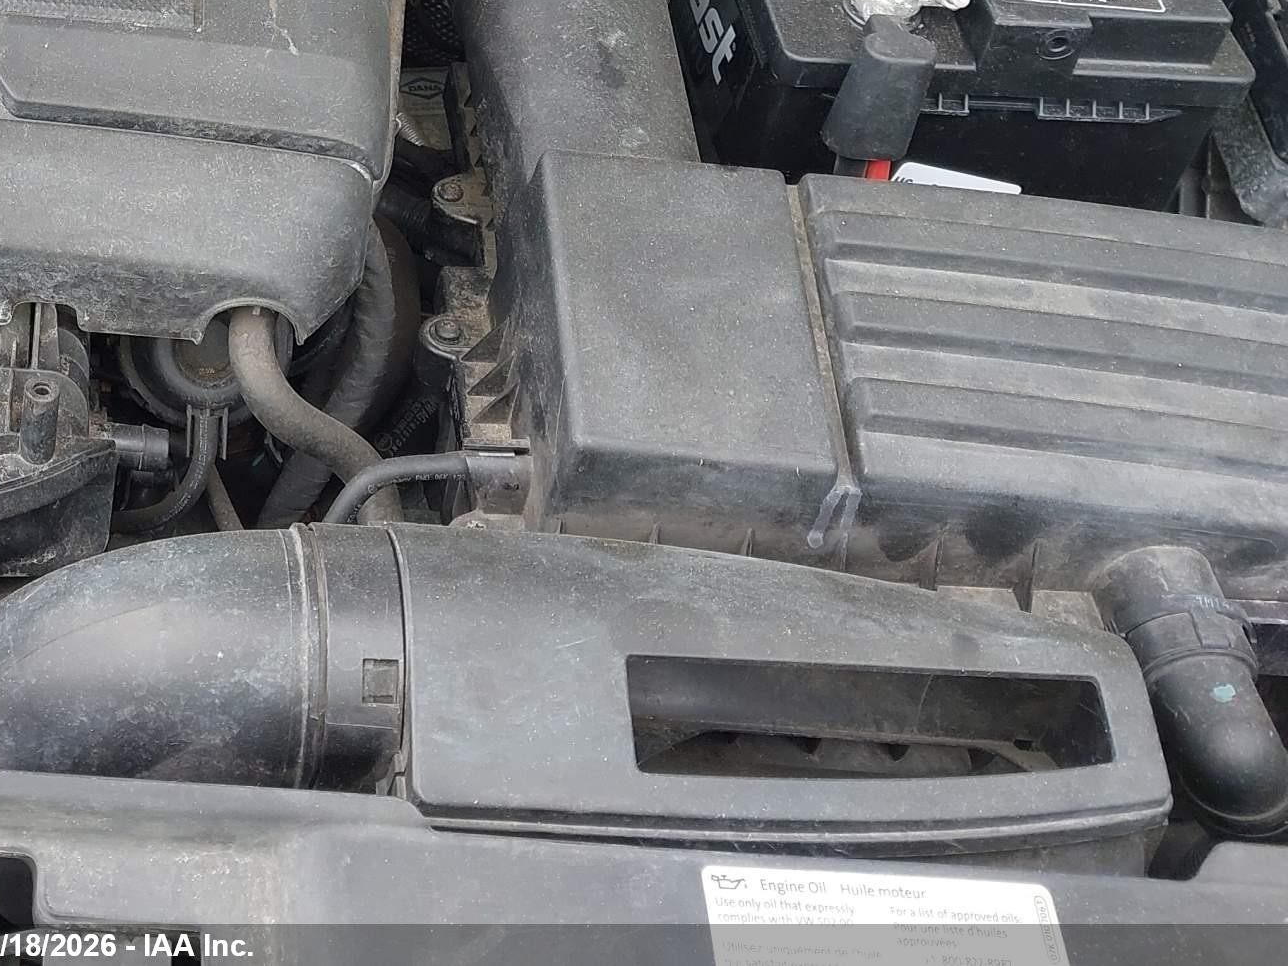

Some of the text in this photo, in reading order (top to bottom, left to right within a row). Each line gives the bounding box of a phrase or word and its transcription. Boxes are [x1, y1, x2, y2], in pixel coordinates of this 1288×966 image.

[760, 879, 827, 895] Engine Oil
[840, 884, 927, 899] Huile moteur
[715, 897, 855, 915] Use only oil that expressly
[890, 905, 907, 915] For
[919, 907, 934, 918] list
[951, 910, 999, 923] approved
[718, 912, 763, 925] complies
[769, 914, 793, 925] with
[893, 922, 918, 932] Pour
[921, 925, 940, 934] une
[967, 927, 1008, 938] d'huiles
